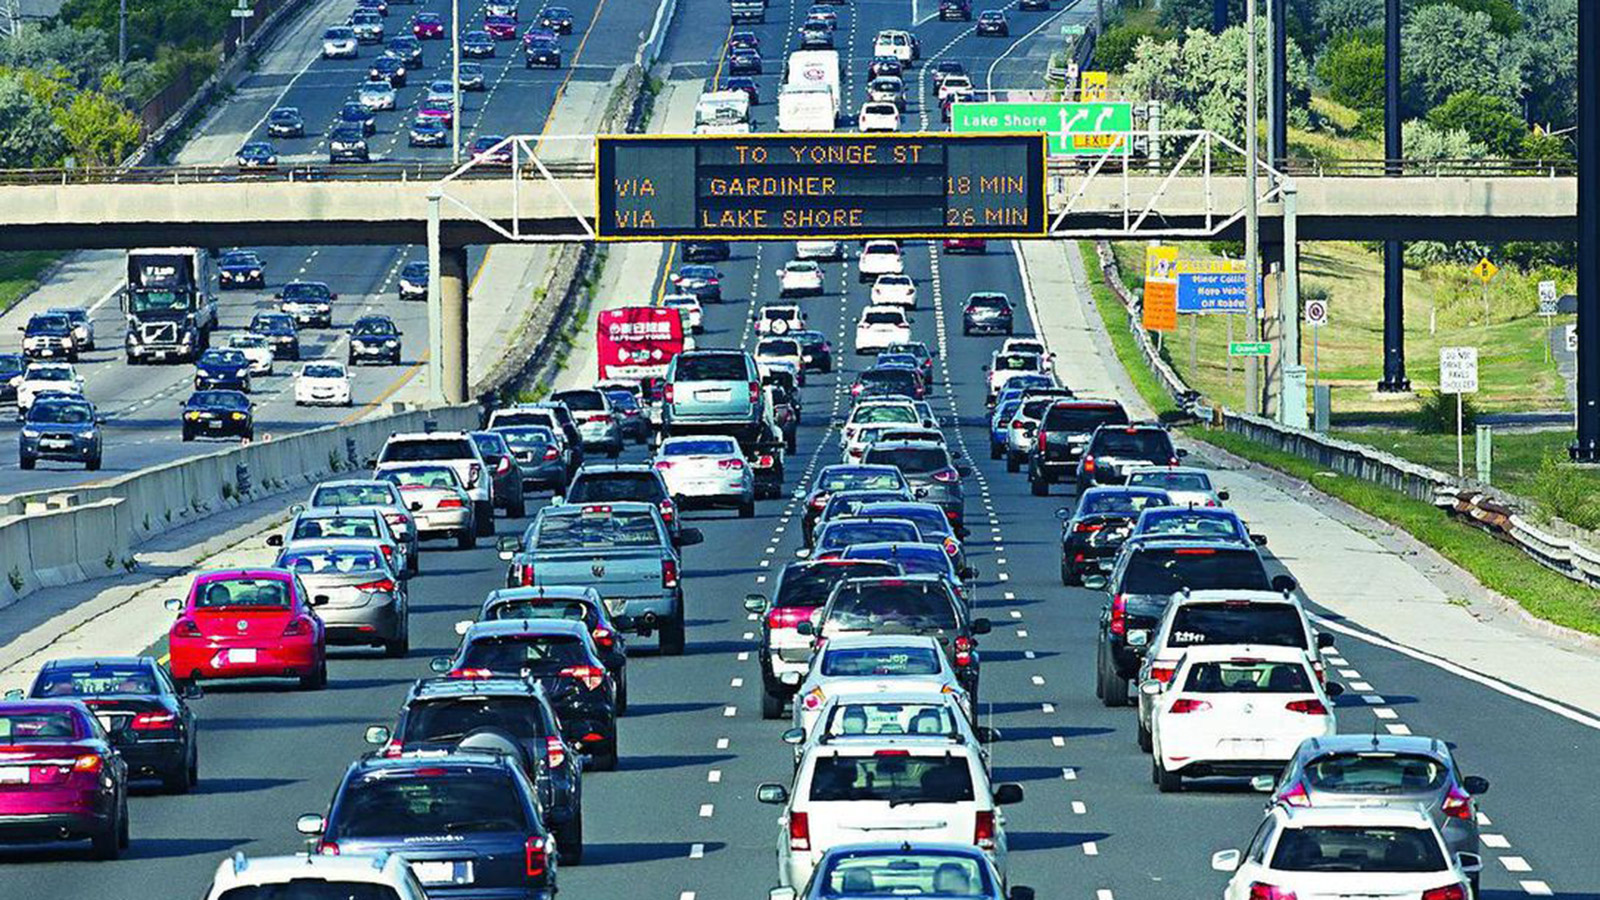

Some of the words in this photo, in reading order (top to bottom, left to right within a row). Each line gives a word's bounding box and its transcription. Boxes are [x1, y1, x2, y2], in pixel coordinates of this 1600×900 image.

[963, 114, 998, 126] Lake
[1004, 114, 1047, 126] Shore
[1085, 134, 1111, 145] EXIT
[735, 146, 768, 164] TO
[790, 146, 877, 164] YONGE
[893, 145, 923, 163] ST
[614, 178, 656, 197] VIA
[710, 177, 836, 196] GARDINER
[947, 176, 971, 194] 18
[980, 175, 1024, 194] MIN
[614, 210, 656, 229] VIA
[703, 209, 768, 228] LAKE
[782, 209, 864, 228] SHORE
[947, 208, 976, 227] 26
[985, 208, 1029, 226] MIN
